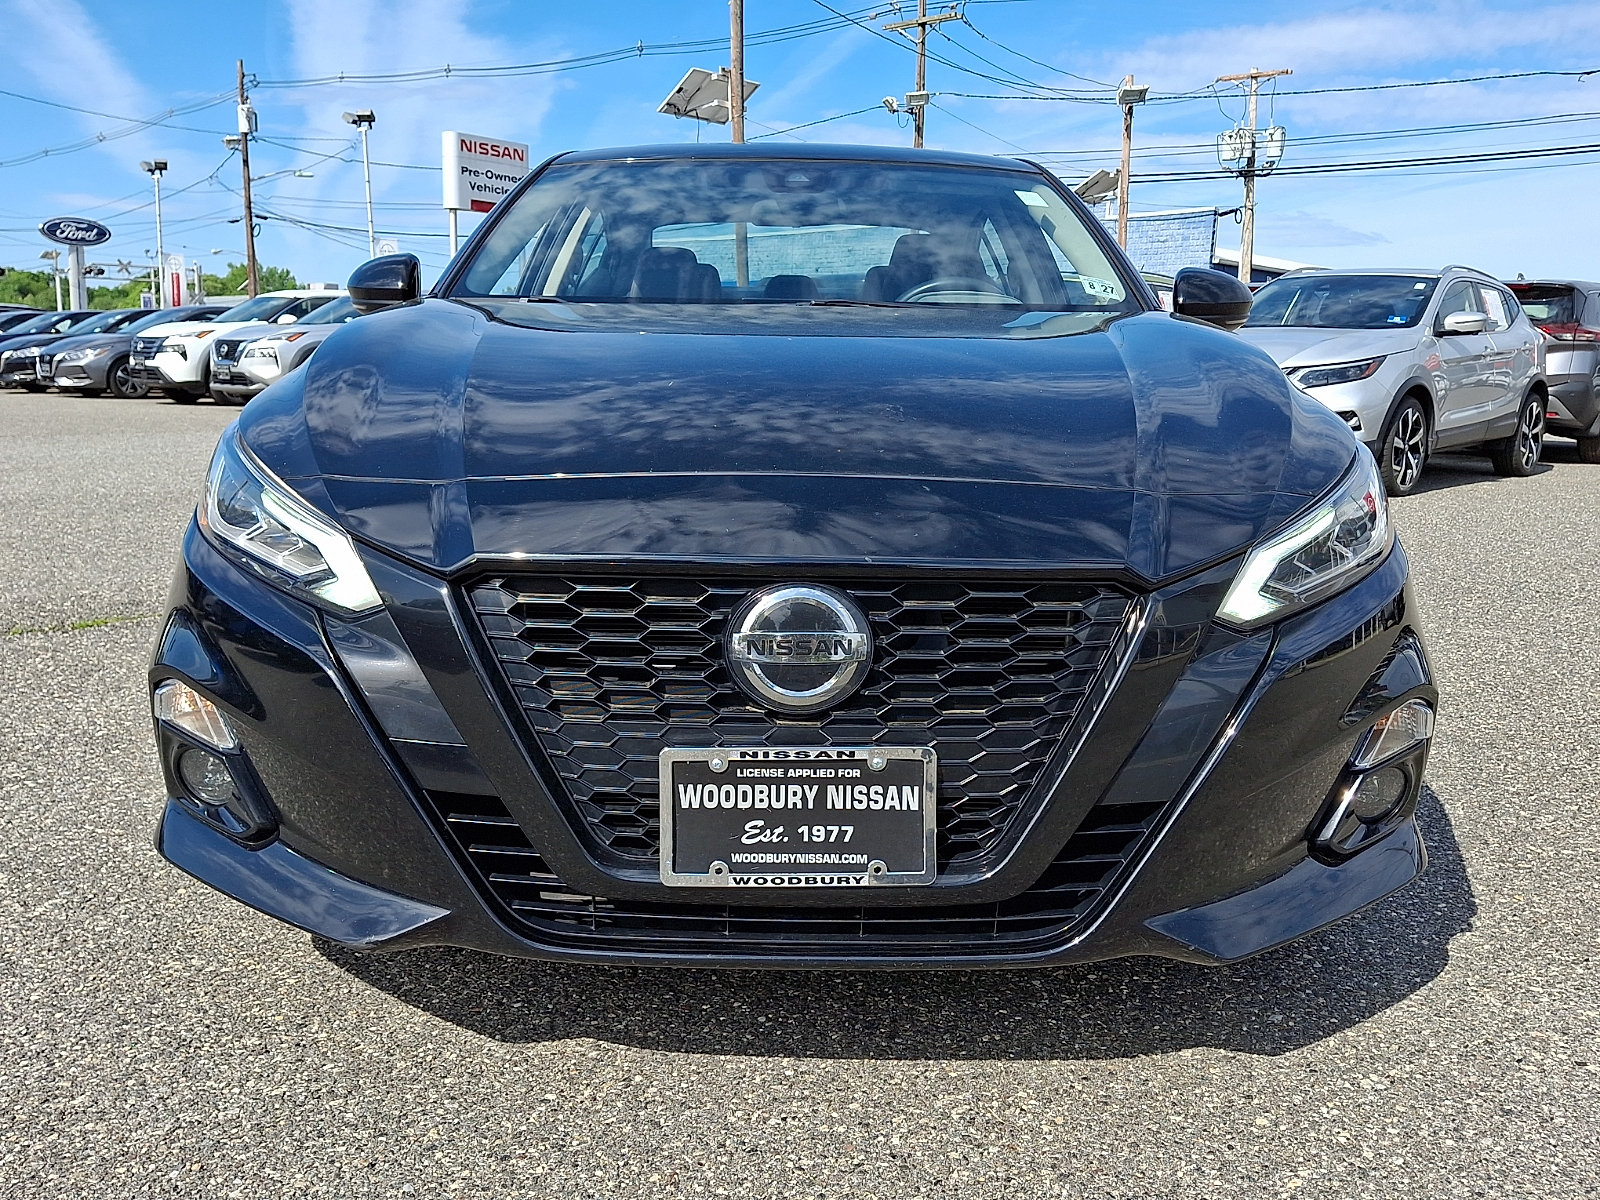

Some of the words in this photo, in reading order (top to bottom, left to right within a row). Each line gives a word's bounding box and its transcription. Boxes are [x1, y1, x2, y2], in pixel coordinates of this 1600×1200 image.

[460, 139, 525, 162] NISSAN
[55, 221, 98, 241] Ford
[1088, 281, 1096, 290] 8
[1101, 284, 1115, 295] 27
[746, 639, 852, 656] NISSAN
[739, 751, 855, 759] NISSAN
[737, 768, 784, 778] LICENSE
[787, 768, 835, 778] APPLIED
[838, 768, 861, 778] FOR
[678, 783, 819, 810] WOODBURY
[826, 784, 920, 811] NISSAN
[740, 819, 789, 845] Est.
[797, 825, 854, 843] 1977
[730, 853, 868, 864] WOODBURYNISSAN.COM
[732, 876, 865, 885] WOODBURY
